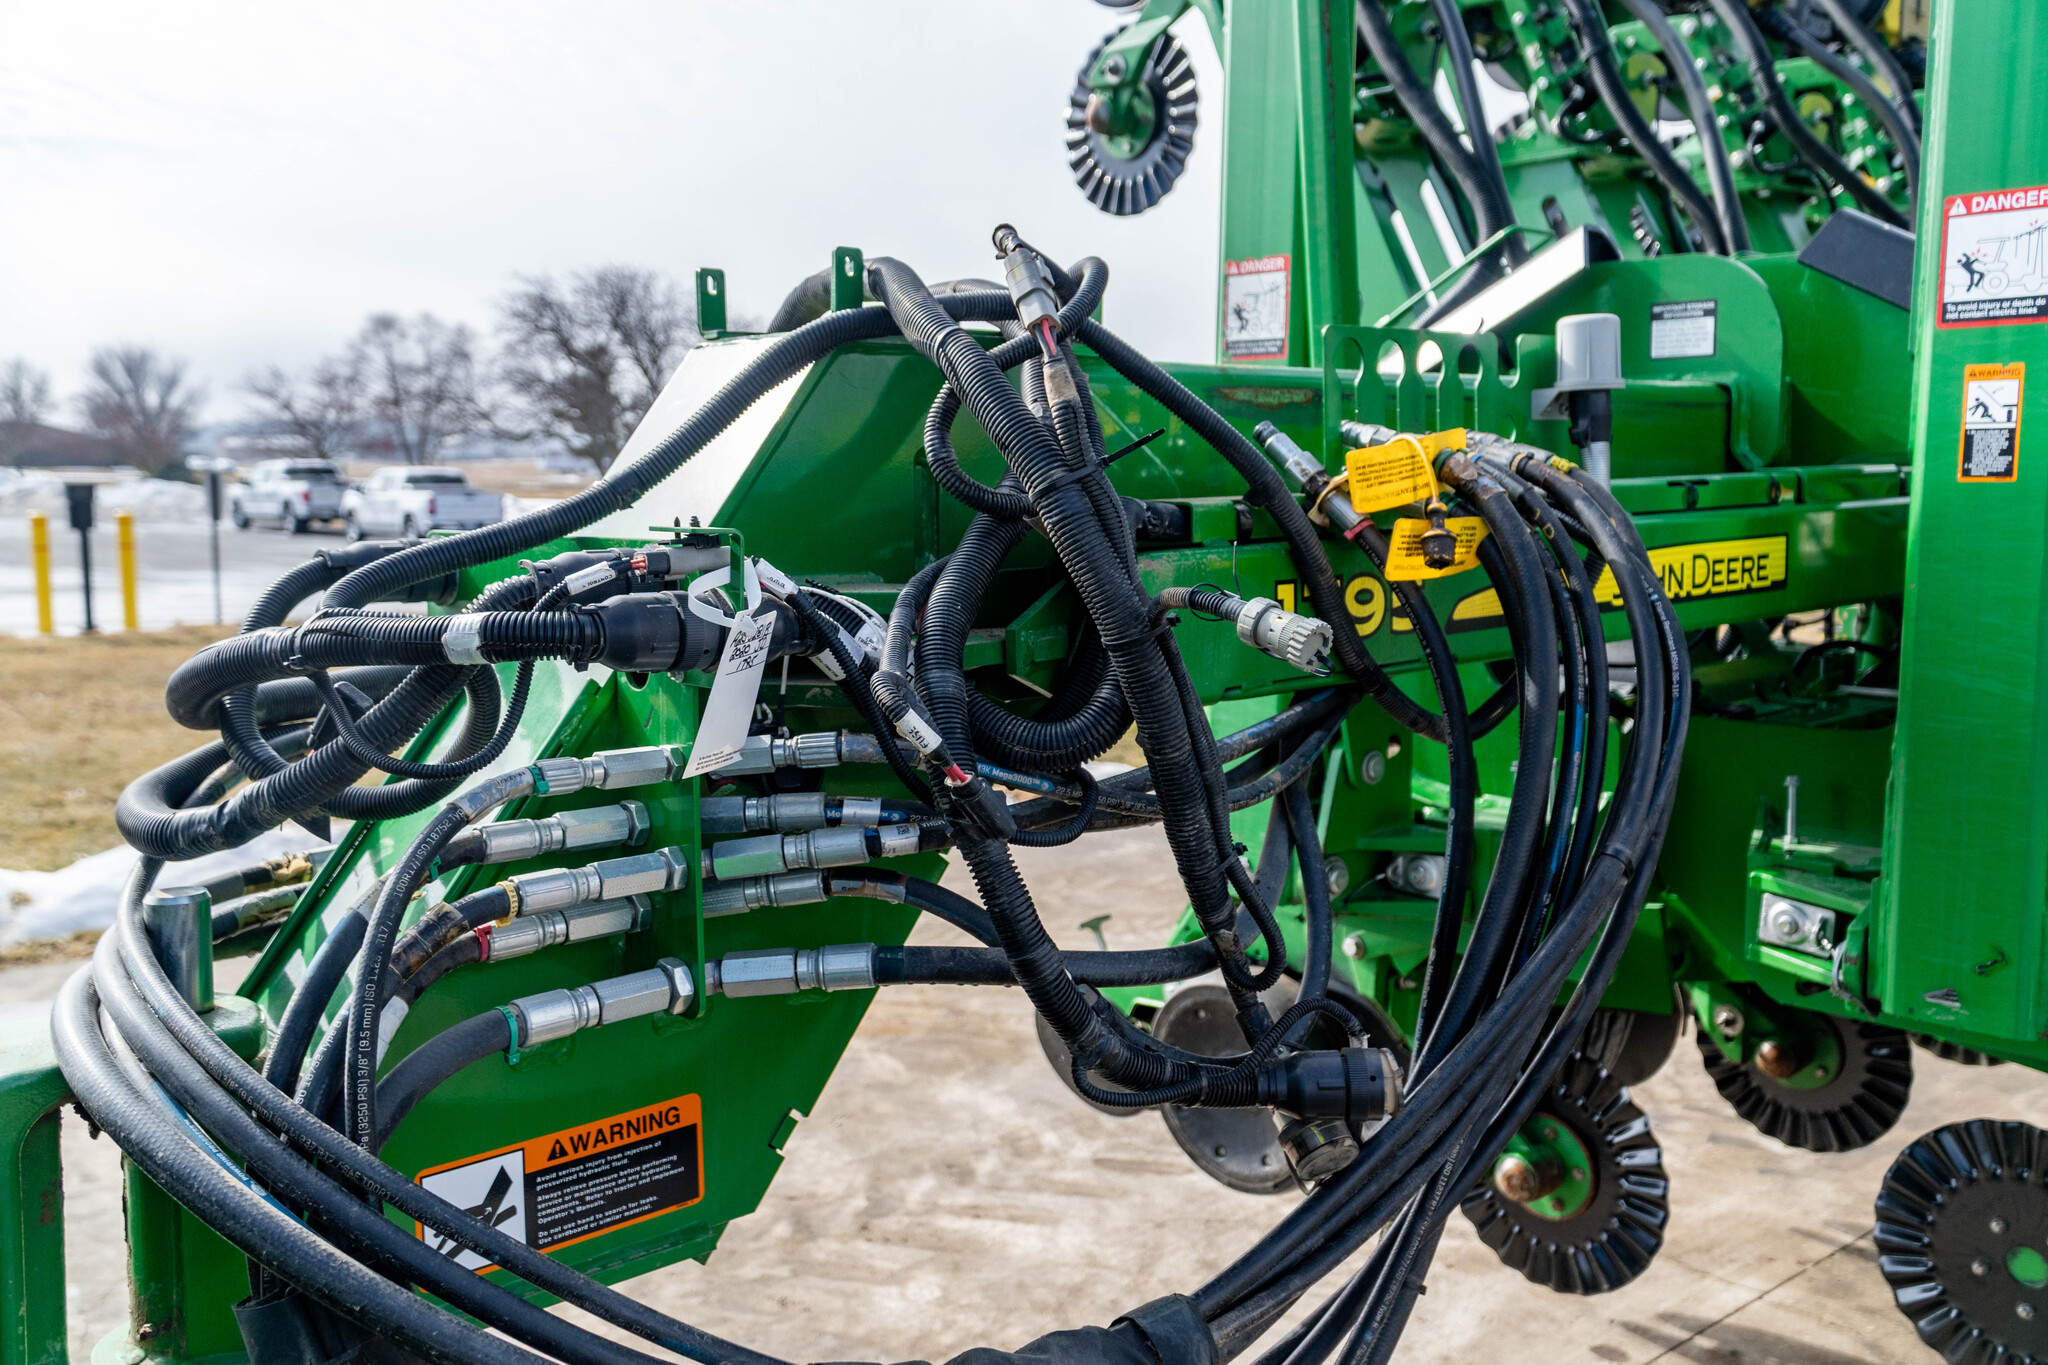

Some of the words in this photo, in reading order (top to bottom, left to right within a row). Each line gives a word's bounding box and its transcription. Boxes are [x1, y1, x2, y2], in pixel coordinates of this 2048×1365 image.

[1240, 257, 1285, 274] DANGER
[1946, 311, 1959, 319] not
[1960, 309, 1988, 319] contact
[1989, 307, 2017, 317] electric
[2019, 306, 2037, 314] lines
[1947, 303, 1956, 312] To
[1957, 302, 1977, 311] avoid
[1979, 300, 2000, 310] injury
[2012, 298, 2034, 306] death
[2035, 297, 2046, 306] do
[1978, 368, 2020, 377] WARNING
[1692, 553, 1770, 591] DEERE
[1655, 601, 1667, 622] Flame
[1663, 620, 1676, 651] Resistant
[1670, 650, 1680, 672] MSHA
[729, 644, 750, 662] 2020
[908, 726, 928, 748] FUSE
[1055, 785, 1072, 796] 22.5
[1071, 790, 1084, 798] MP
[448, 807, 465, 822] Typ
[427, 819, 452, 846] 18752
[364, 983, 376, 1001] ISO
[362, 1003, 376, 1028] mm)
[358, 1030, 371, 1051] (9.5
[358, 1054, 370, 1077] 3/8"
[357, 1079, 370, 1100] PSI)
[357, 1104, 372, 1134] (3250
[569, 1106, 680, 1154] WARNING
[216, 1152, 249, 1181] POWERING
[536, 1172, 557, 1183] Avoid
[558, 1165, 584, 1177] serious
[585, 1158, 606, 1169] injury
[607, 1153, 622, 1161] from
[624, 1144, 653, 1157] injection
[536, 1174, 577, 1191] pressurized
[579, 1164, 610, 1179] hydraulic
[612, 1158, 630, 1167] fluid.
[537, 1190, 562, 1202] Always
[563, 1182, 587, 1194] relieve
[588, 1174, 618, 1187] pressure
[619, 1166, 641, 1177] before
[642, 1155, 677, 1171] performing
[537, 1198, 563, 1209] service
[574, 1181, 616, 1198] maintenance
[641, 1164, 671, 1177] hydraulic
[537, 1201, 581, 1217] components.
[585, 1193, 604, 1202] Refer
[614, 1182, 637, 1193] tractor
[639, 1177, 650, 1185] and
[652, 1166, 685, 1180] implement
[538, 1209, 574, 1224] Operator's
[576, 1200, 607, 1212] Manuals.
[539, 1236, 552, 1244] Use
[553, 1224, 589, 1240] cardboard
[600, 1213, 622, 1225] similar
[624, 1204, 652, 1217] material.
[550, 1226, 562, 1234] not
[563, 1222, 576, 1230] use
[577, 1216, 594, 1225] hand
[604, 1204, 627, 1216] search
[628, 1201, 639, 1209] for
[640, 1195, 659, 1205] leaks.
